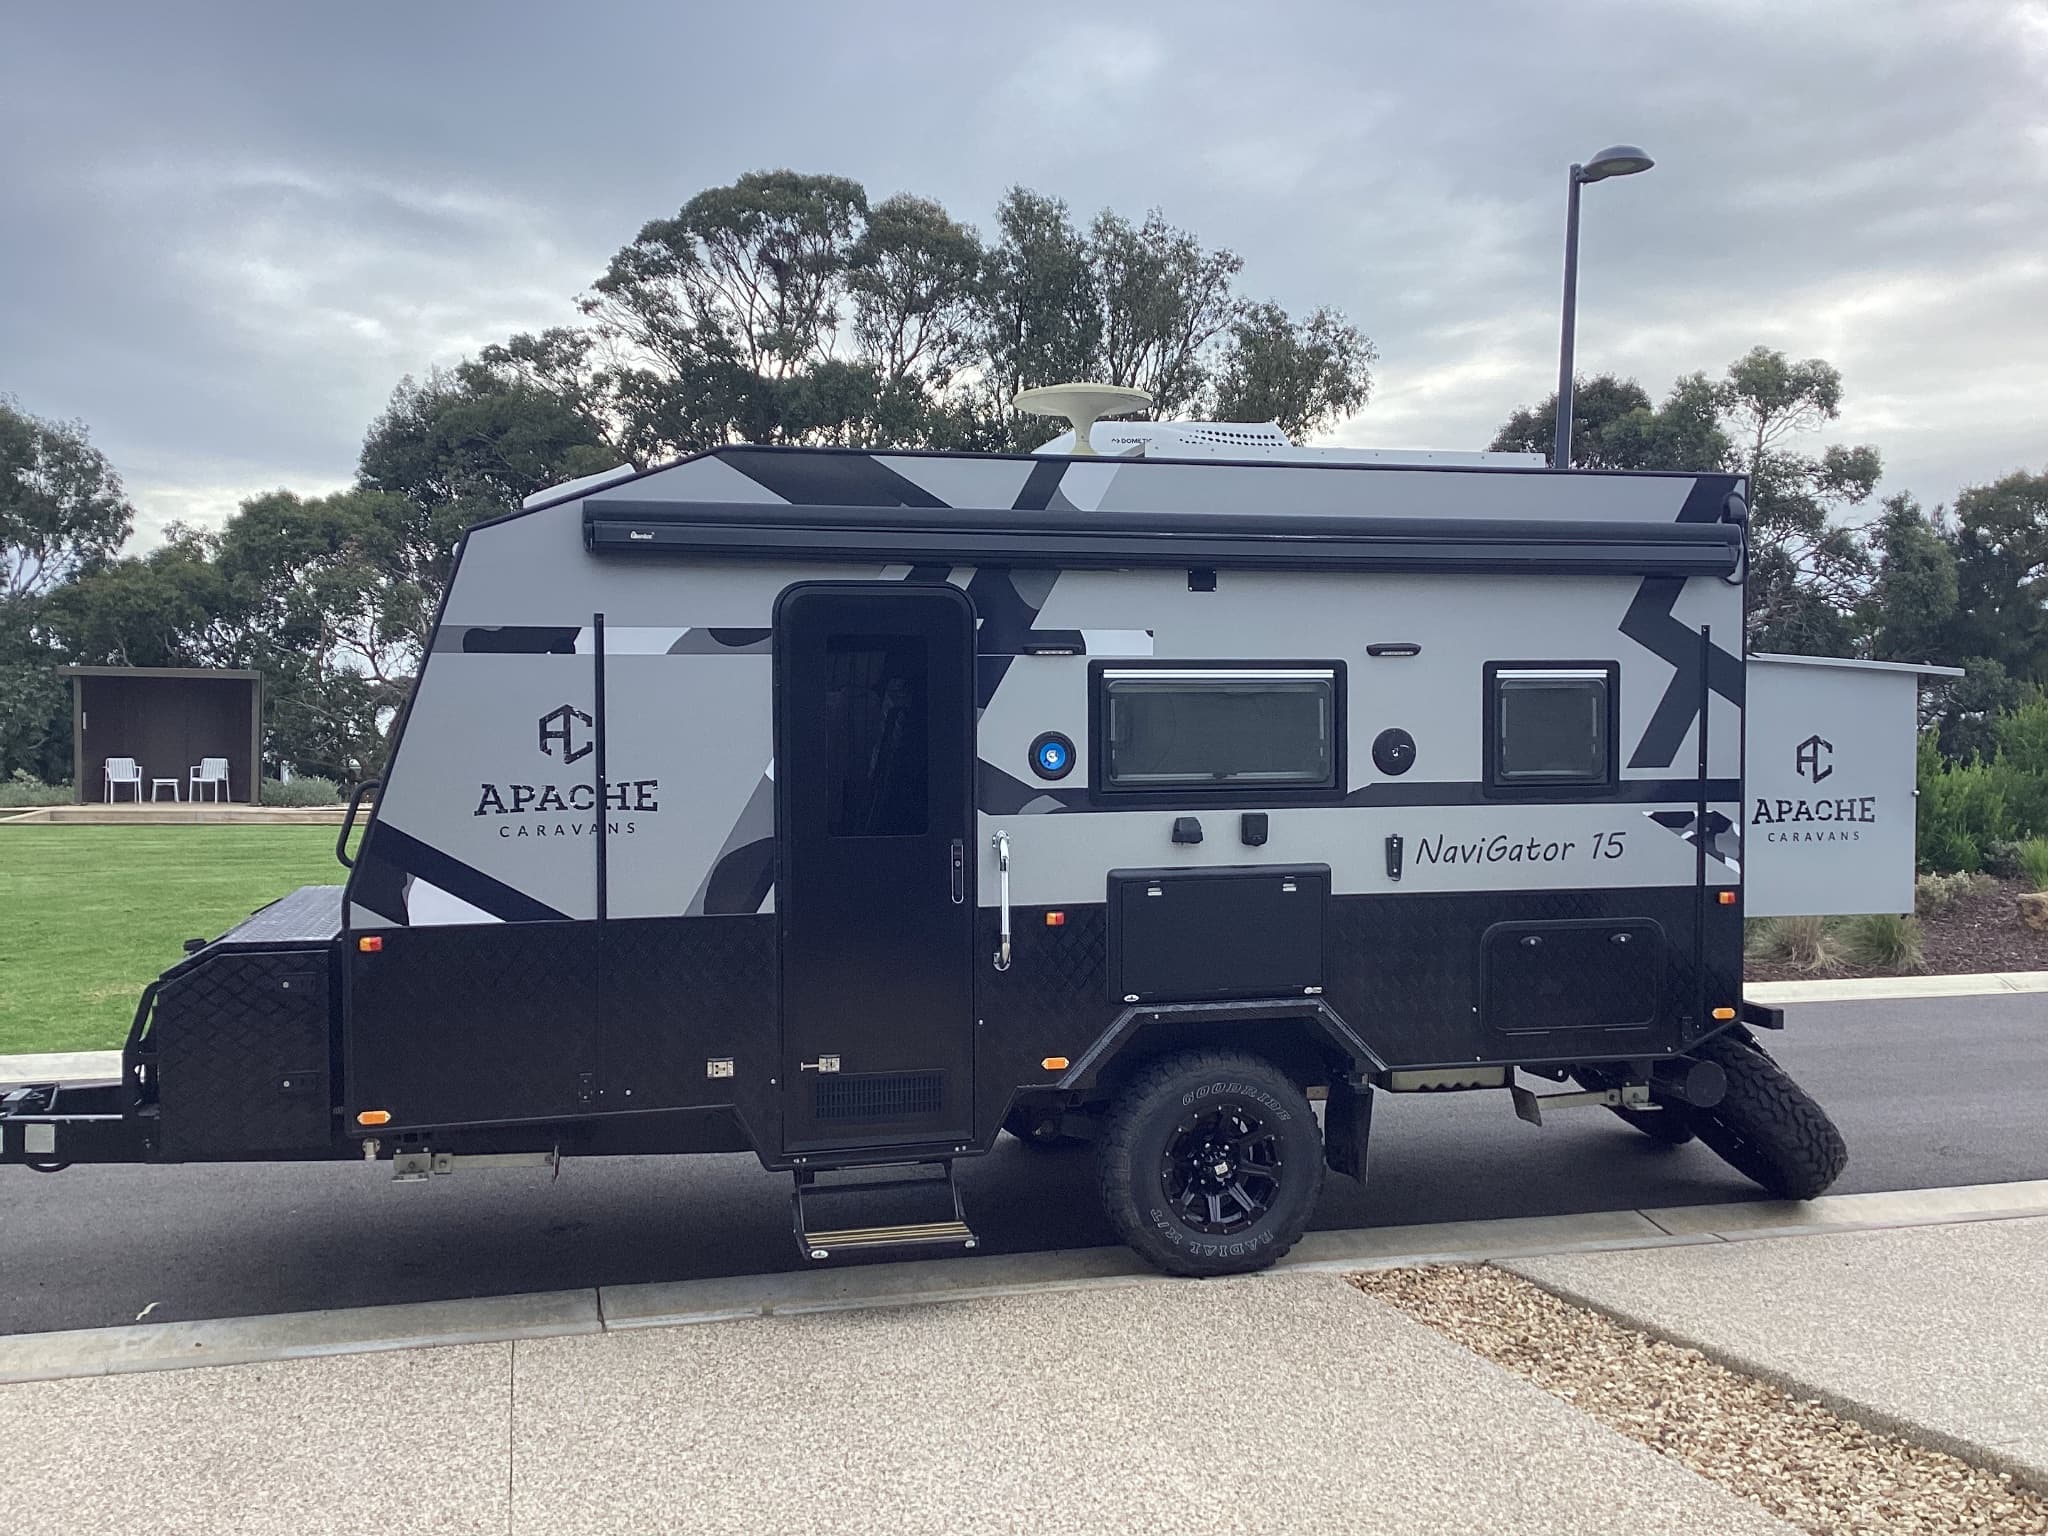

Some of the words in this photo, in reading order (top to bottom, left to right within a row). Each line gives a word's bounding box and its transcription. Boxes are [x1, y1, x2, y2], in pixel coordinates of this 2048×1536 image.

[473, 779, 658, 817] APACHE
[1751, 796, 1876, 825] APACHE
[499, 822, 636, 838] CARAVANS
[1767, 831, 1860, 843] CARAVANS
[1415, 833, 1575, 865] NaviGator
[1592, 831, 1626, 860] 15
[1182, 1082, 1292, 1121] GOODRIDE
[1189, 1229, 1274, 1257] RADIAL
